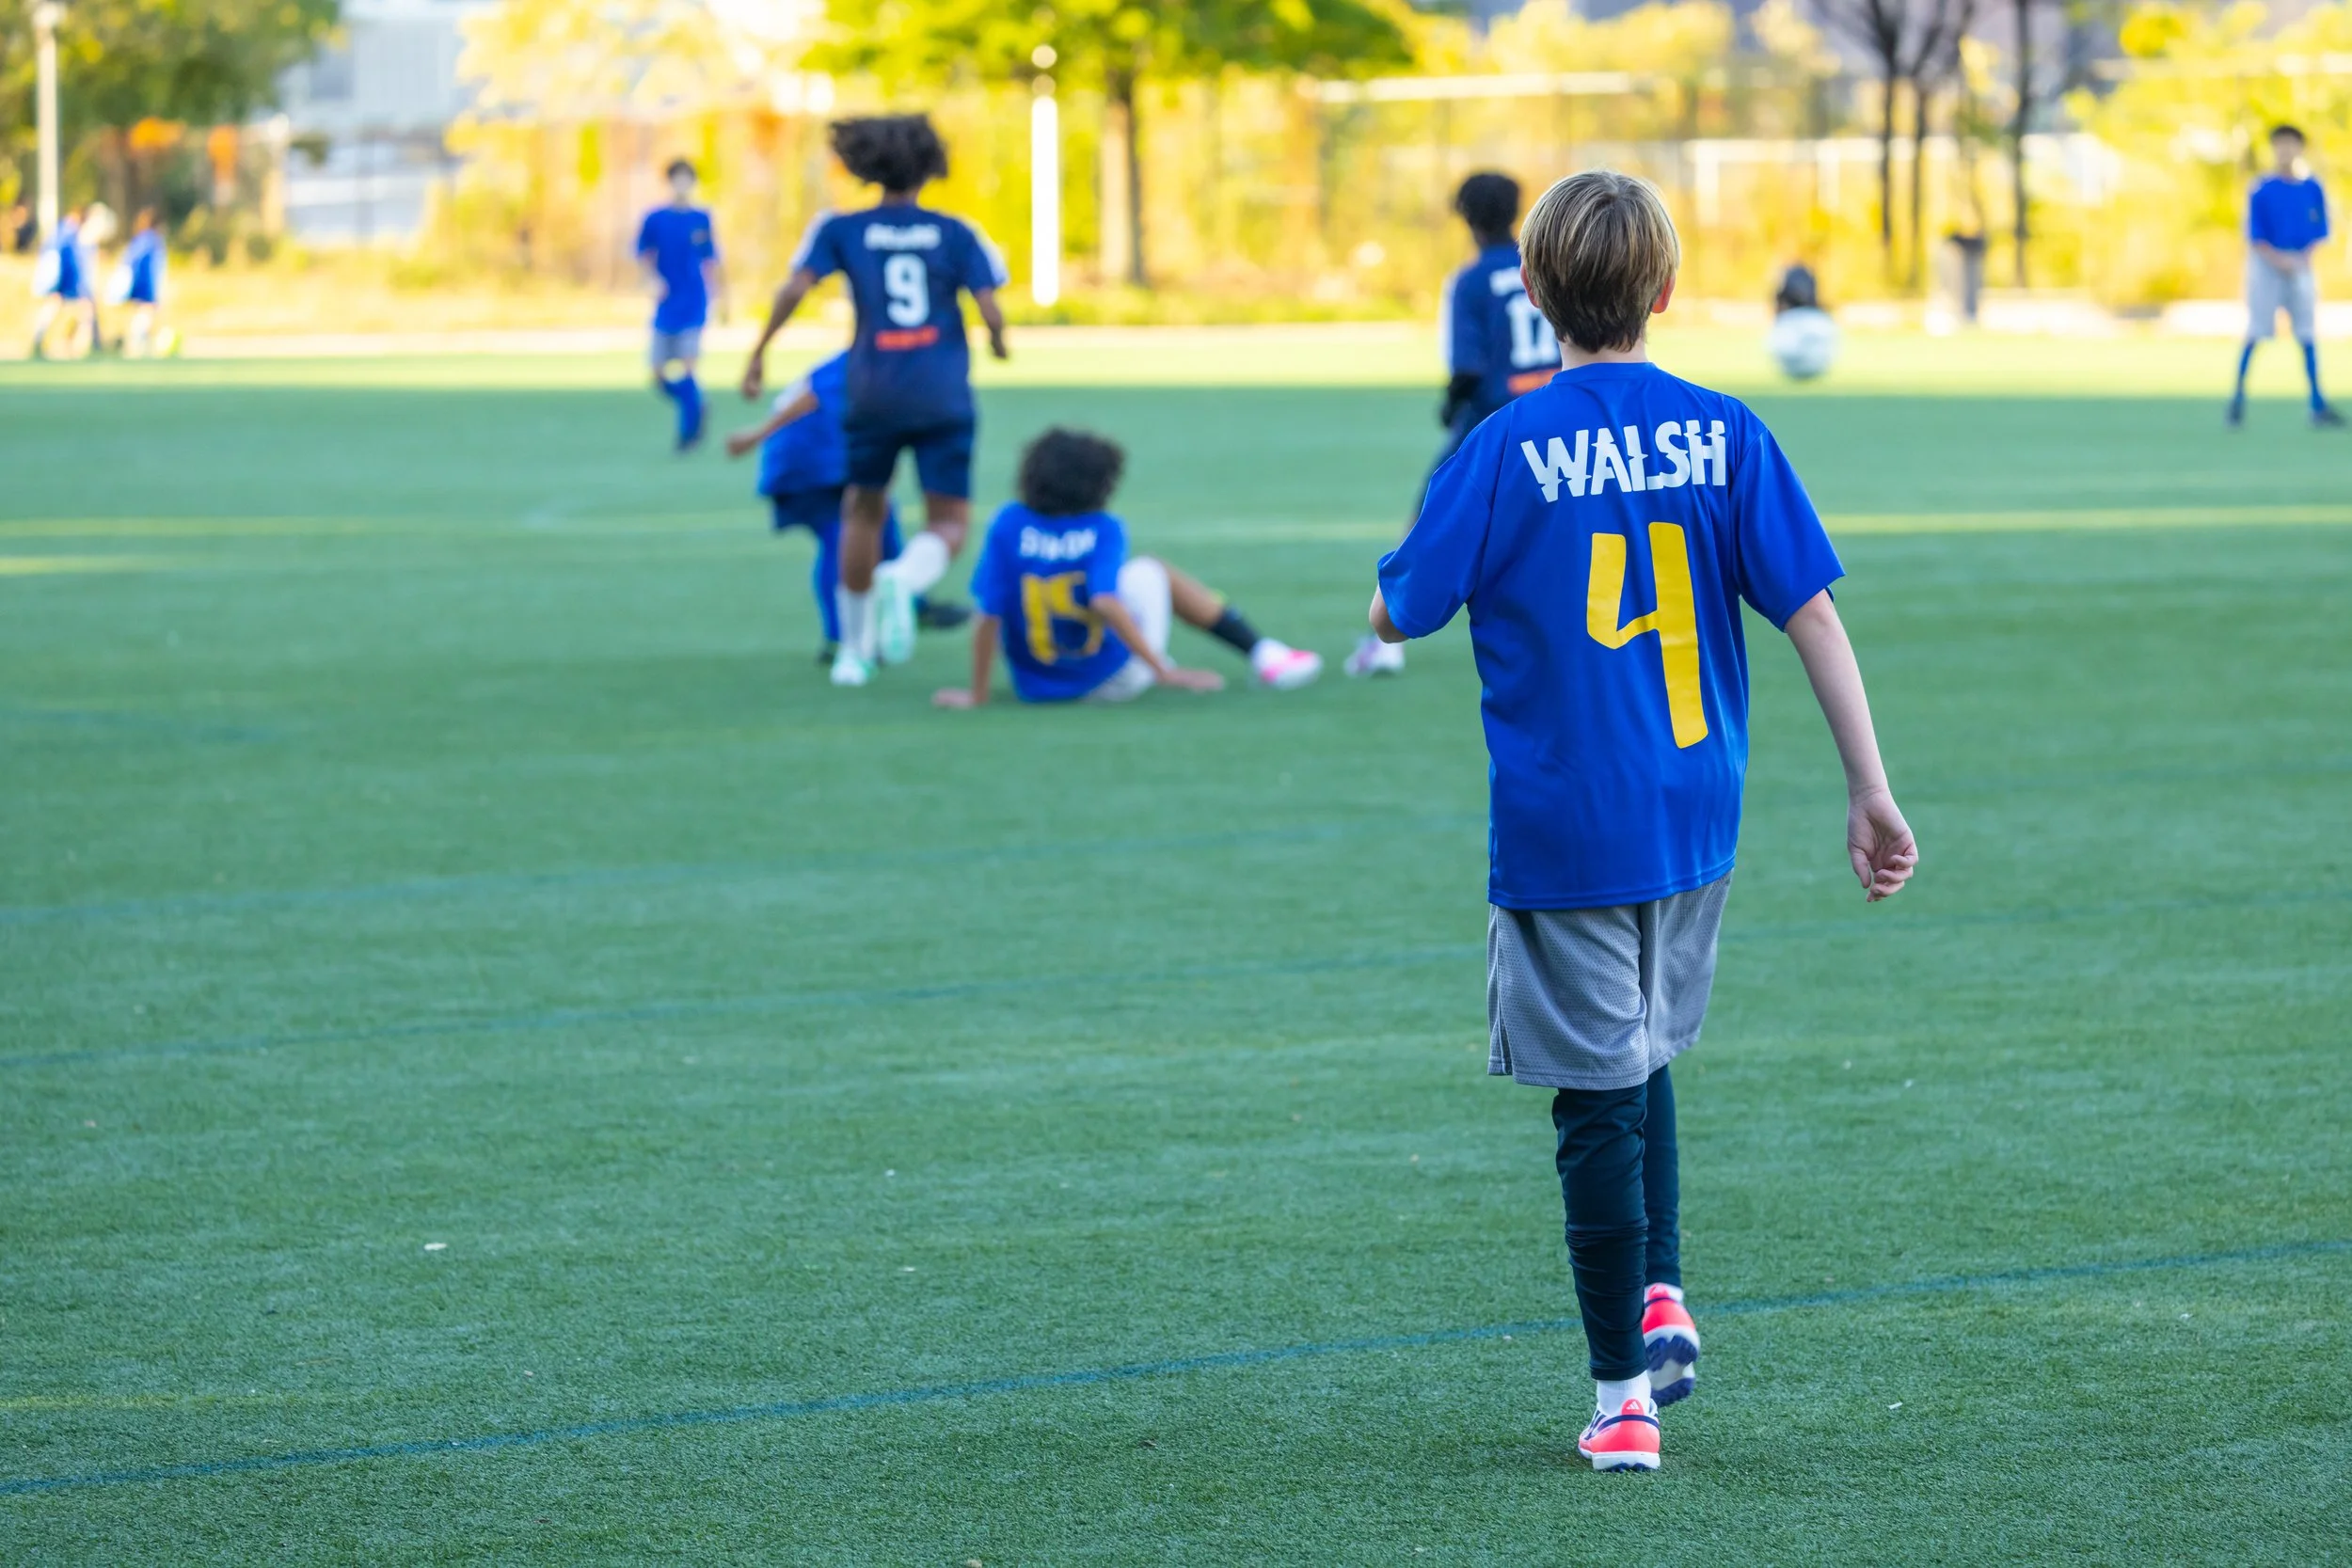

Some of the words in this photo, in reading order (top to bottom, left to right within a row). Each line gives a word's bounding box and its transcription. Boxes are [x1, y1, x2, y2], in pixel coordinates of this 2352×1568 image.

[884, 252, 930, 326] 9
[1520, 420, 1725, 502] WALSH
[1586, 521, 1708, 749] 4
